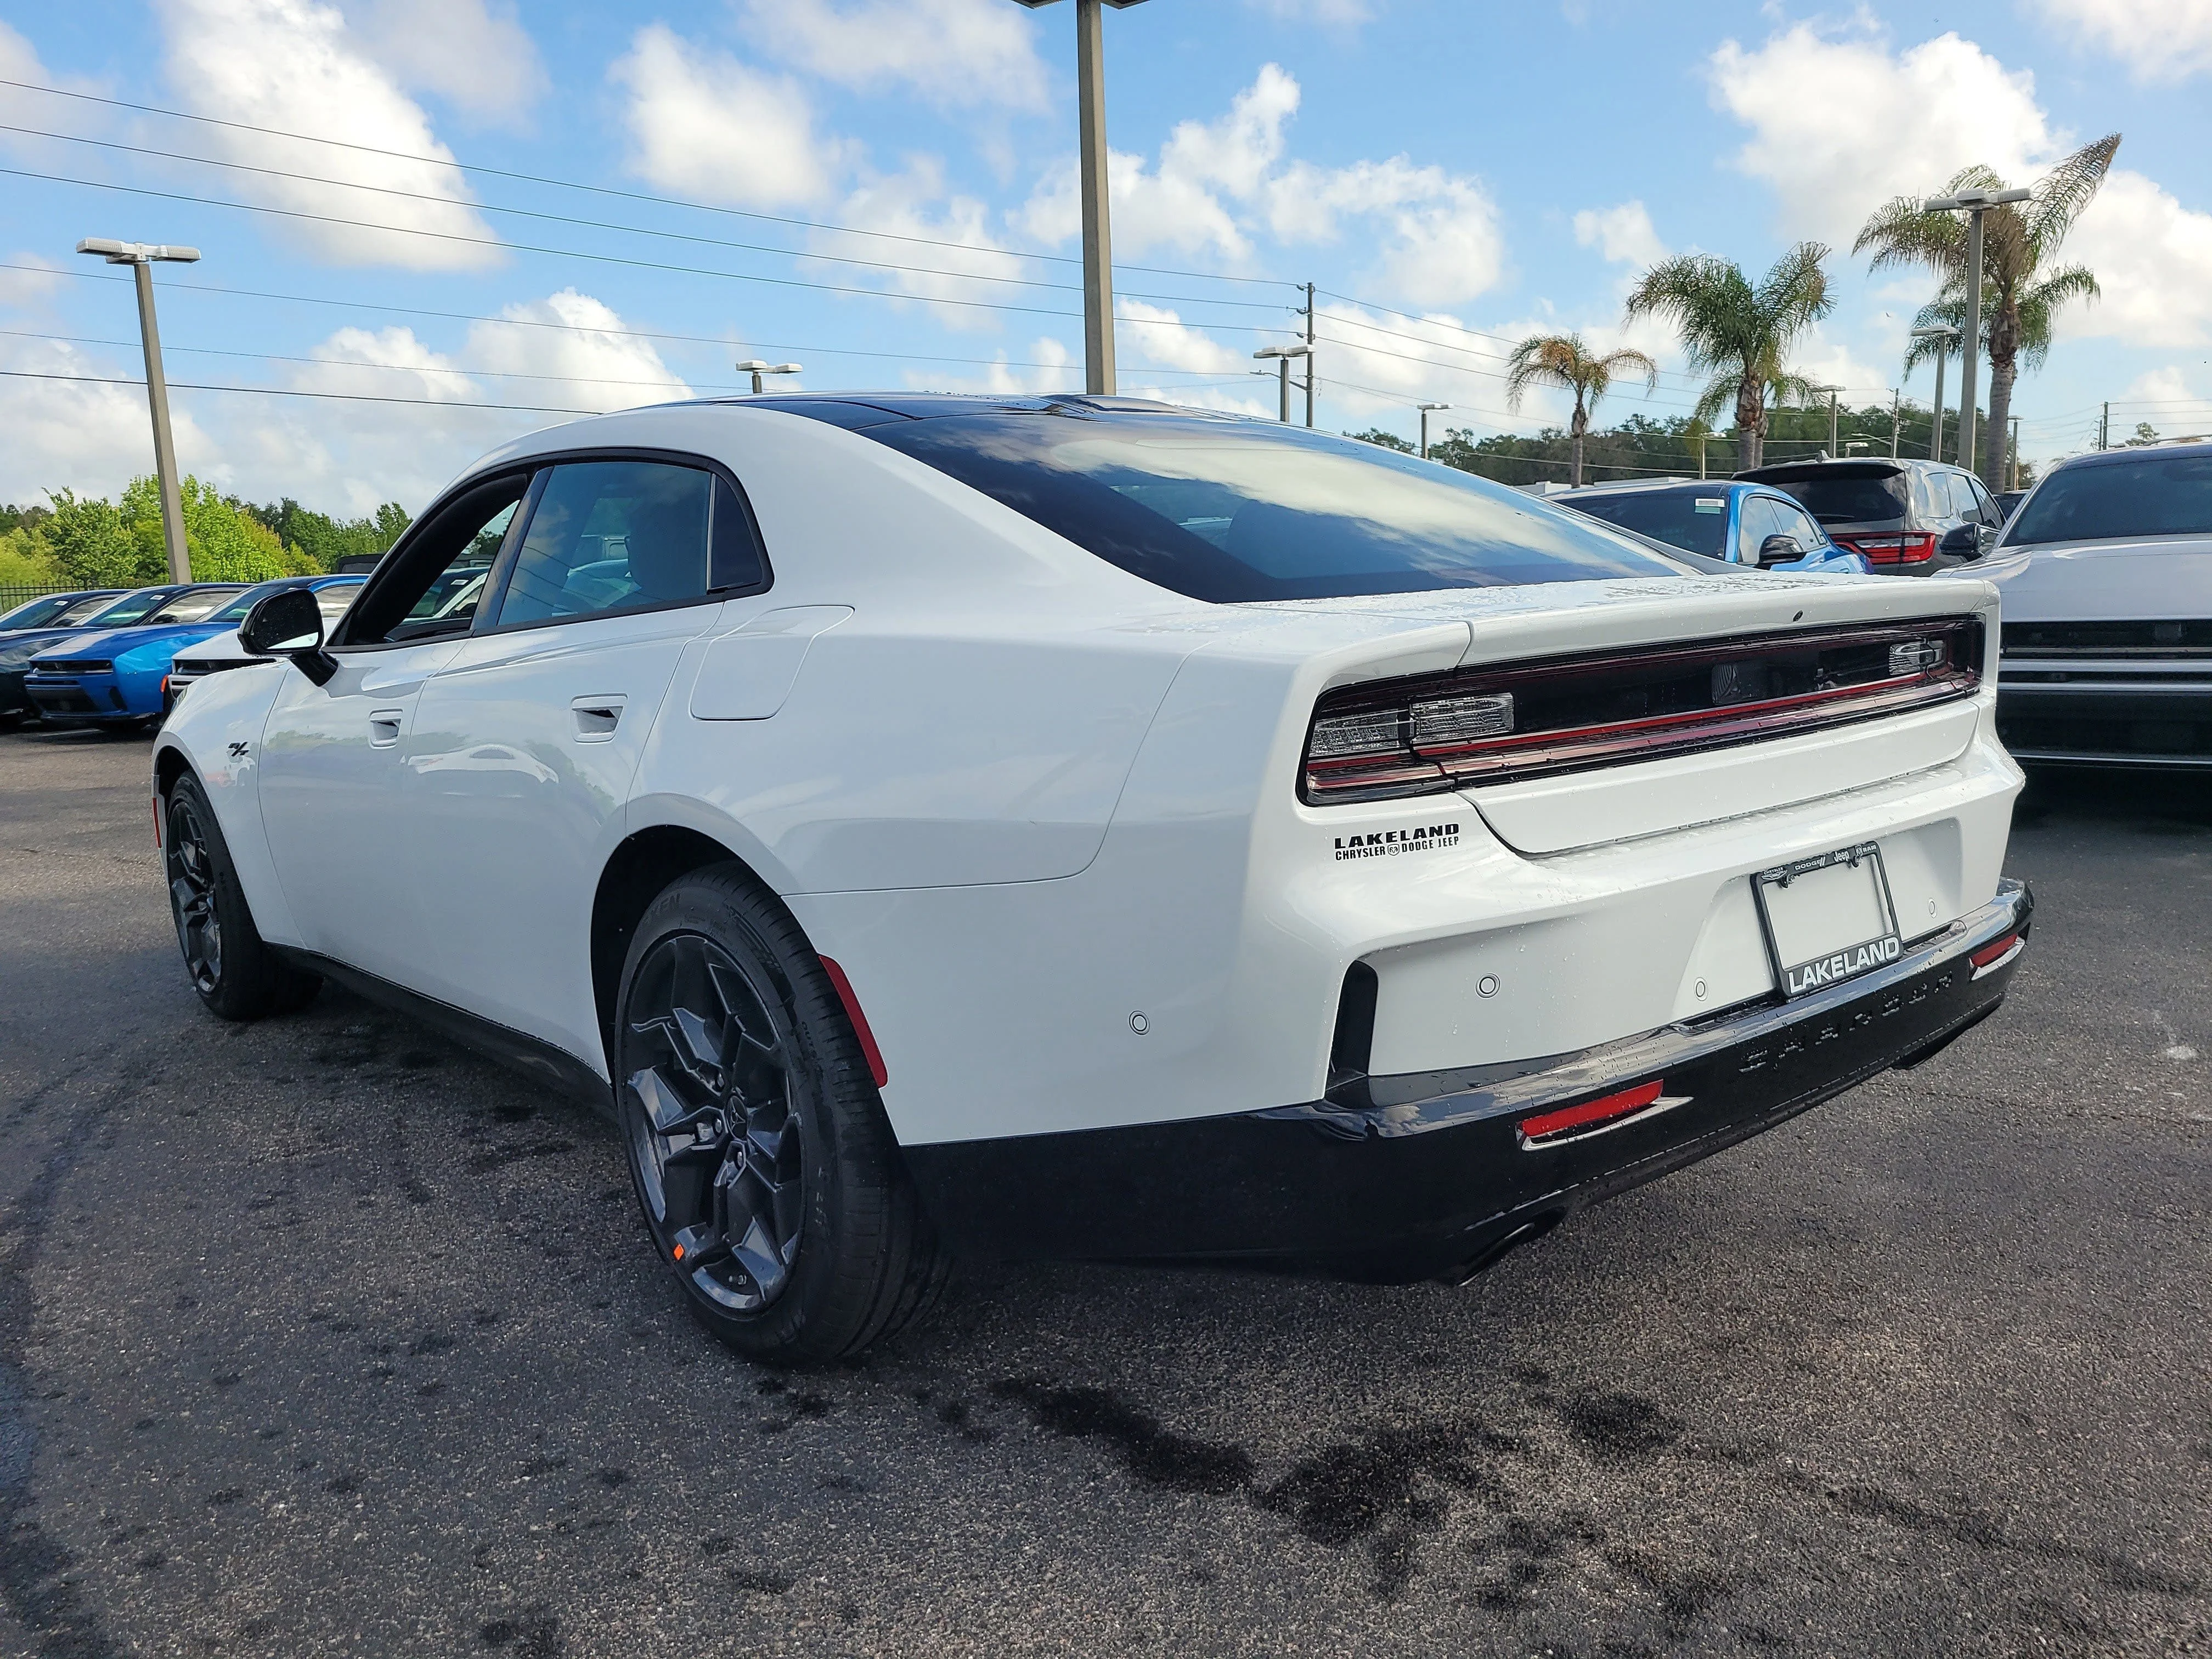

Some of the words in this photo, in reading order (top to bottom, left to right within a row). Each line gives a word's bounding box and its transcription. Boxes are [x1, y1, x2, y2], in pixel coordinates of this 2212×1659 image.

[1334, 823, 1459, 849] LAKELAND
[1335, 845, 1386, 861] CHRYSLER
[1402, 839, 1434, 853] DODGE
[1438, 836, 1459, 848] JEEP
[1763, 867, 1784, 875] CHRYSLER
[1833, 850, 1849, 862] Jeep
[1788, 936, 1900, 994] LAKELAND
